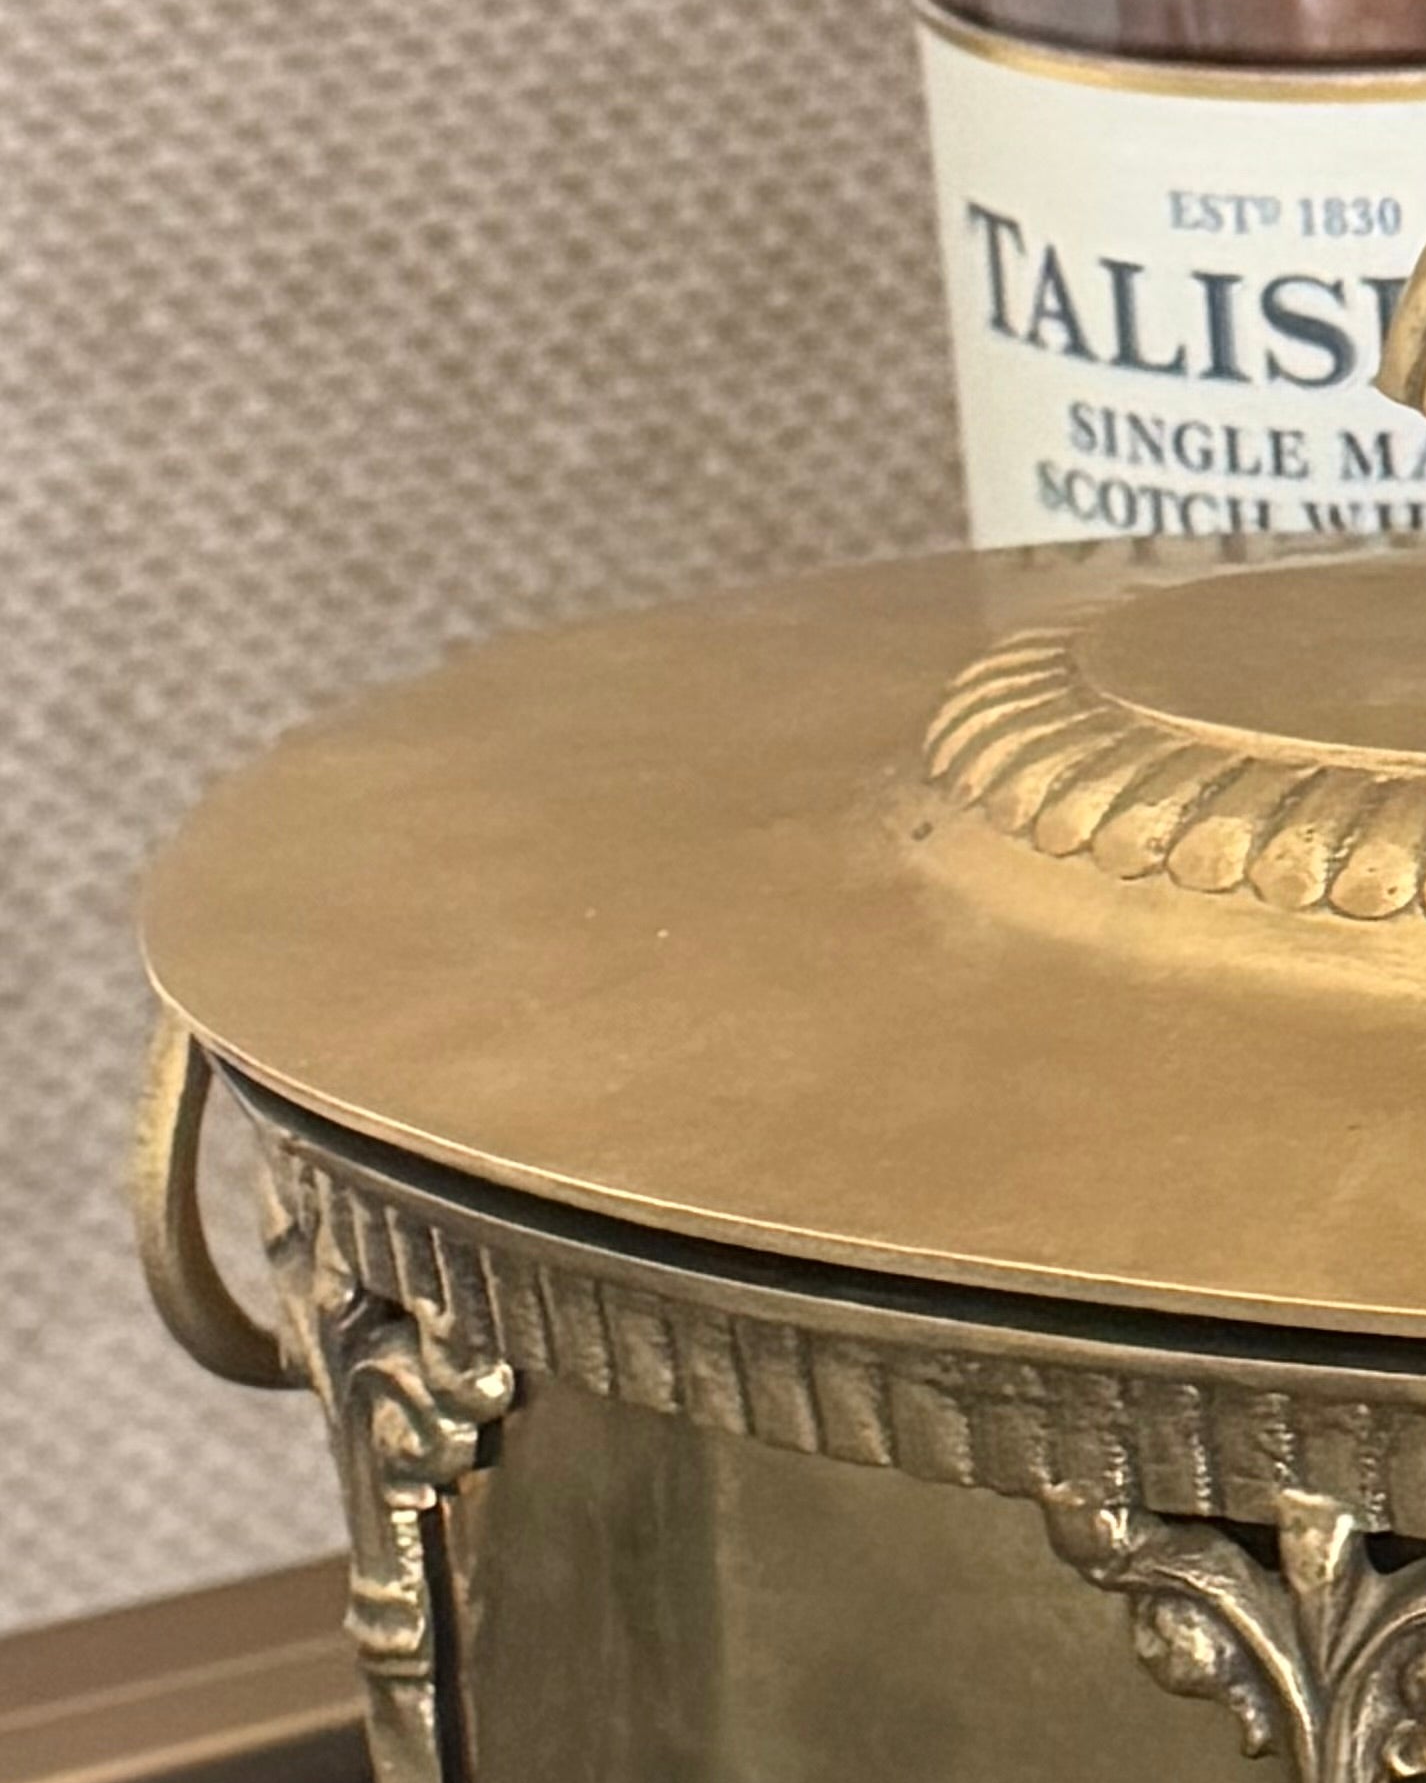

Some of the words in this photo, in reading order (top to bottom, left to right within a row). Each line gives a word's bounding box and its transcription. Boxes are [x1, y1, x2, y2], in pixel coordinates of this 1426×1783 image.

[1298, 196, 1402, 236] 1830
[1069, 399, 1310, 479] SINGLE
[1035, 459, 1273, 534] SCOTCH
